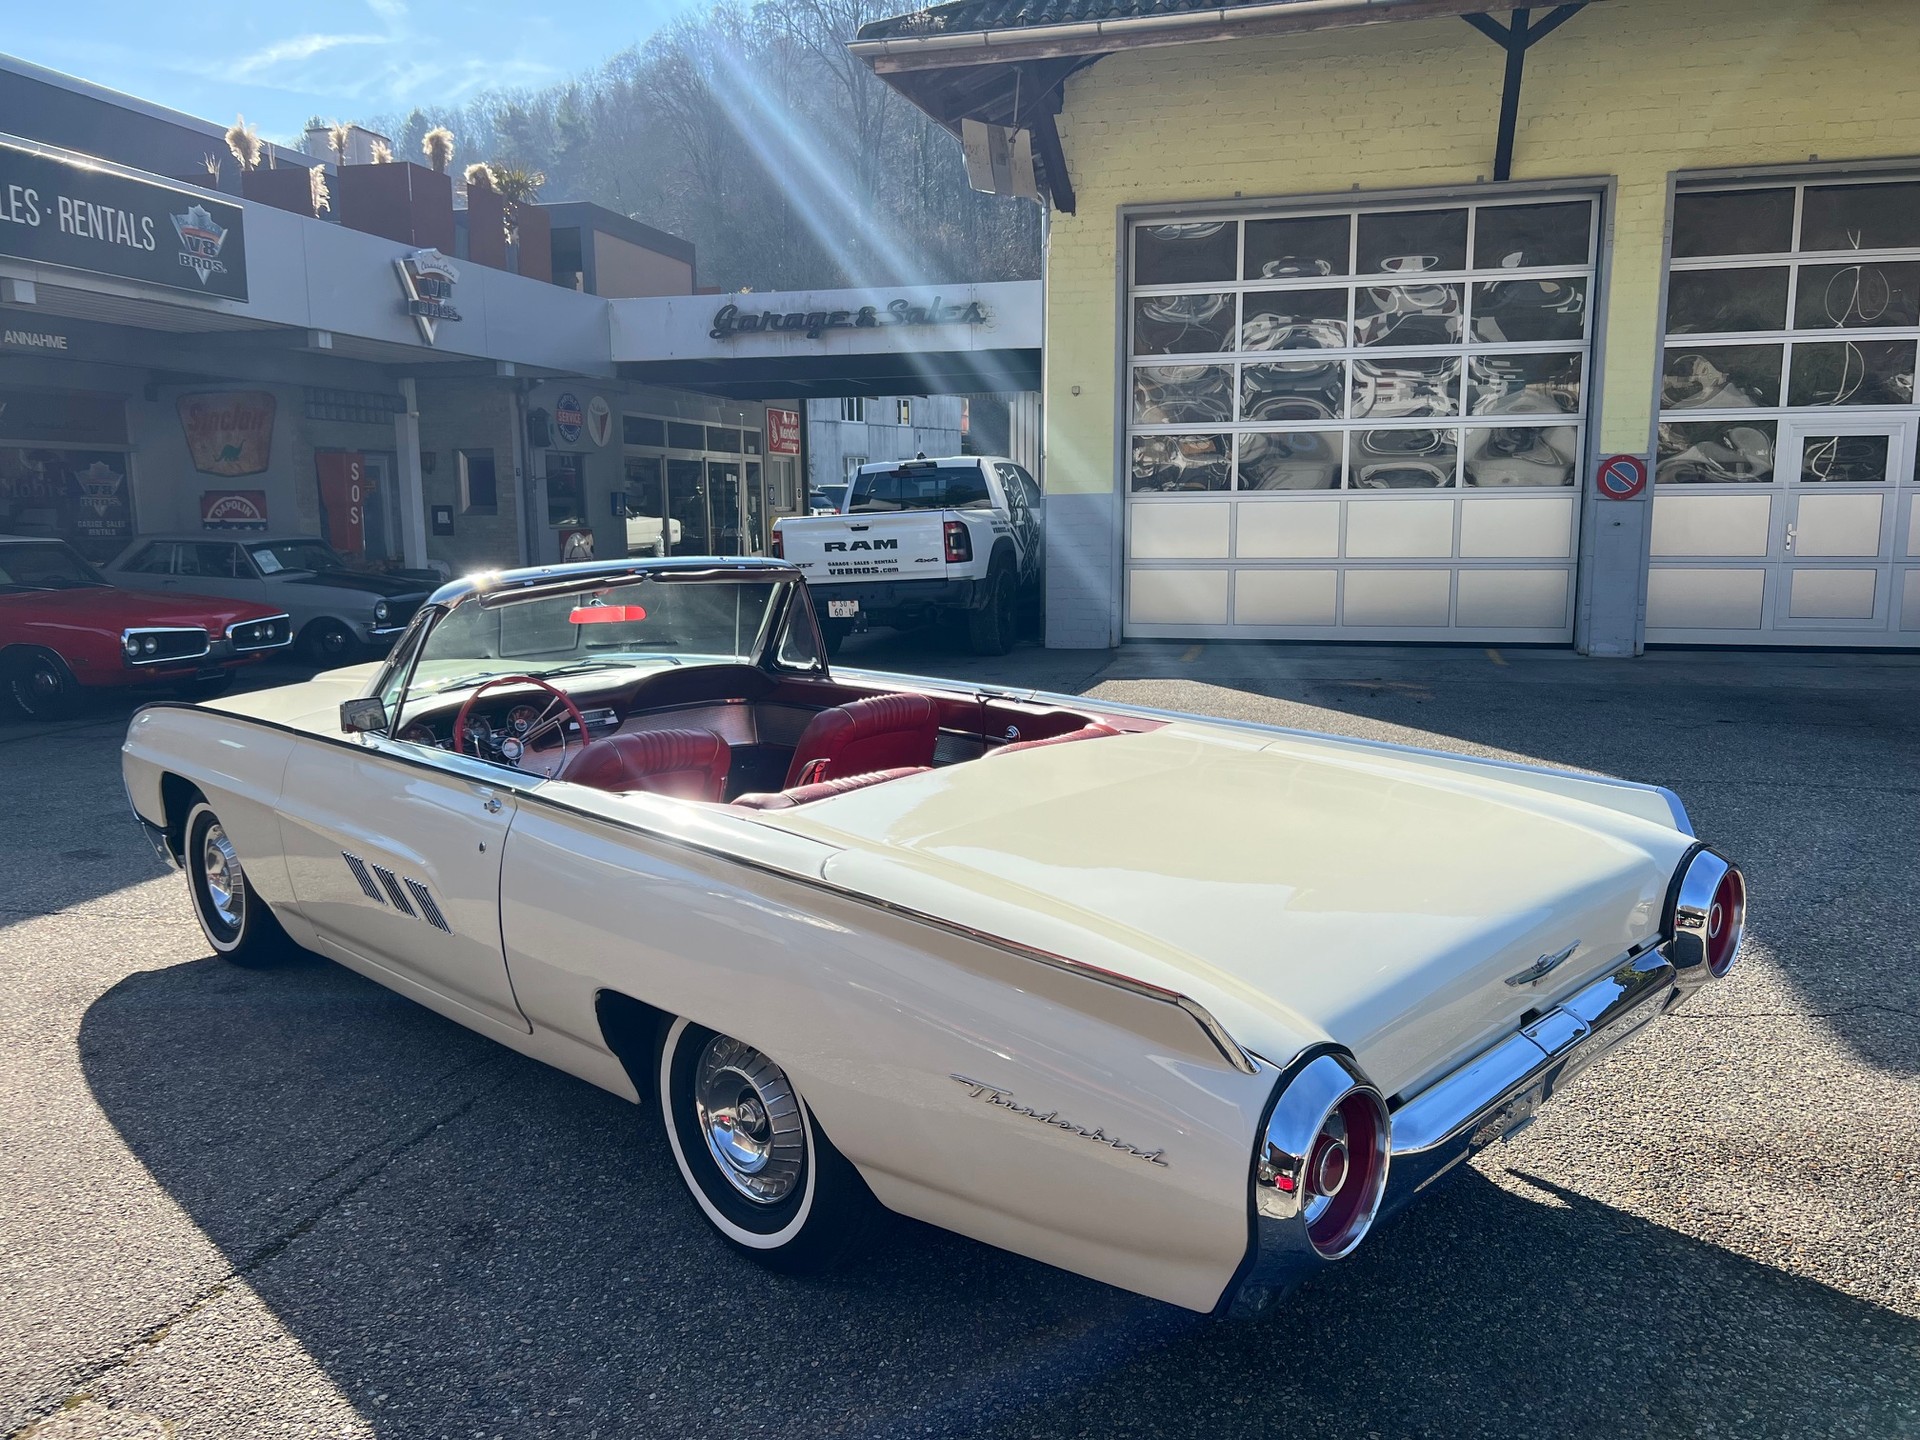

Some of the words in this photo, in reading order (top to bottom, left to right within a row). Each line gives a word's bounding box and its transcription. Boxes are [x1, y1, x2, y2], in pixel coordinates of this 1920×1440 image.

[58, 196, 156, 251] RENTALS
[186, 235, 219, 257] V8
[179, 252, 228, 274] BROS.
[709, 304, 851, 339] Garage
[855, 306, 878, 328] &
[882, 295, 986, 326] Sales
[4, 330, 68, 349] ANNAHME
[188, 402, 268, 431] Sinclair
[558, 411, 582, 424] SERVICE
[351, 462, 360, 524] SOS
[214, 500, 253, 518] DAPOLIN
[77, 520, 103, 528] GARAGE
[824, 539, 898, 552] RAM
[829, 566, 899, 575] V8BROS.com
[949, 1073, 1168, 1167] Thunderbird
